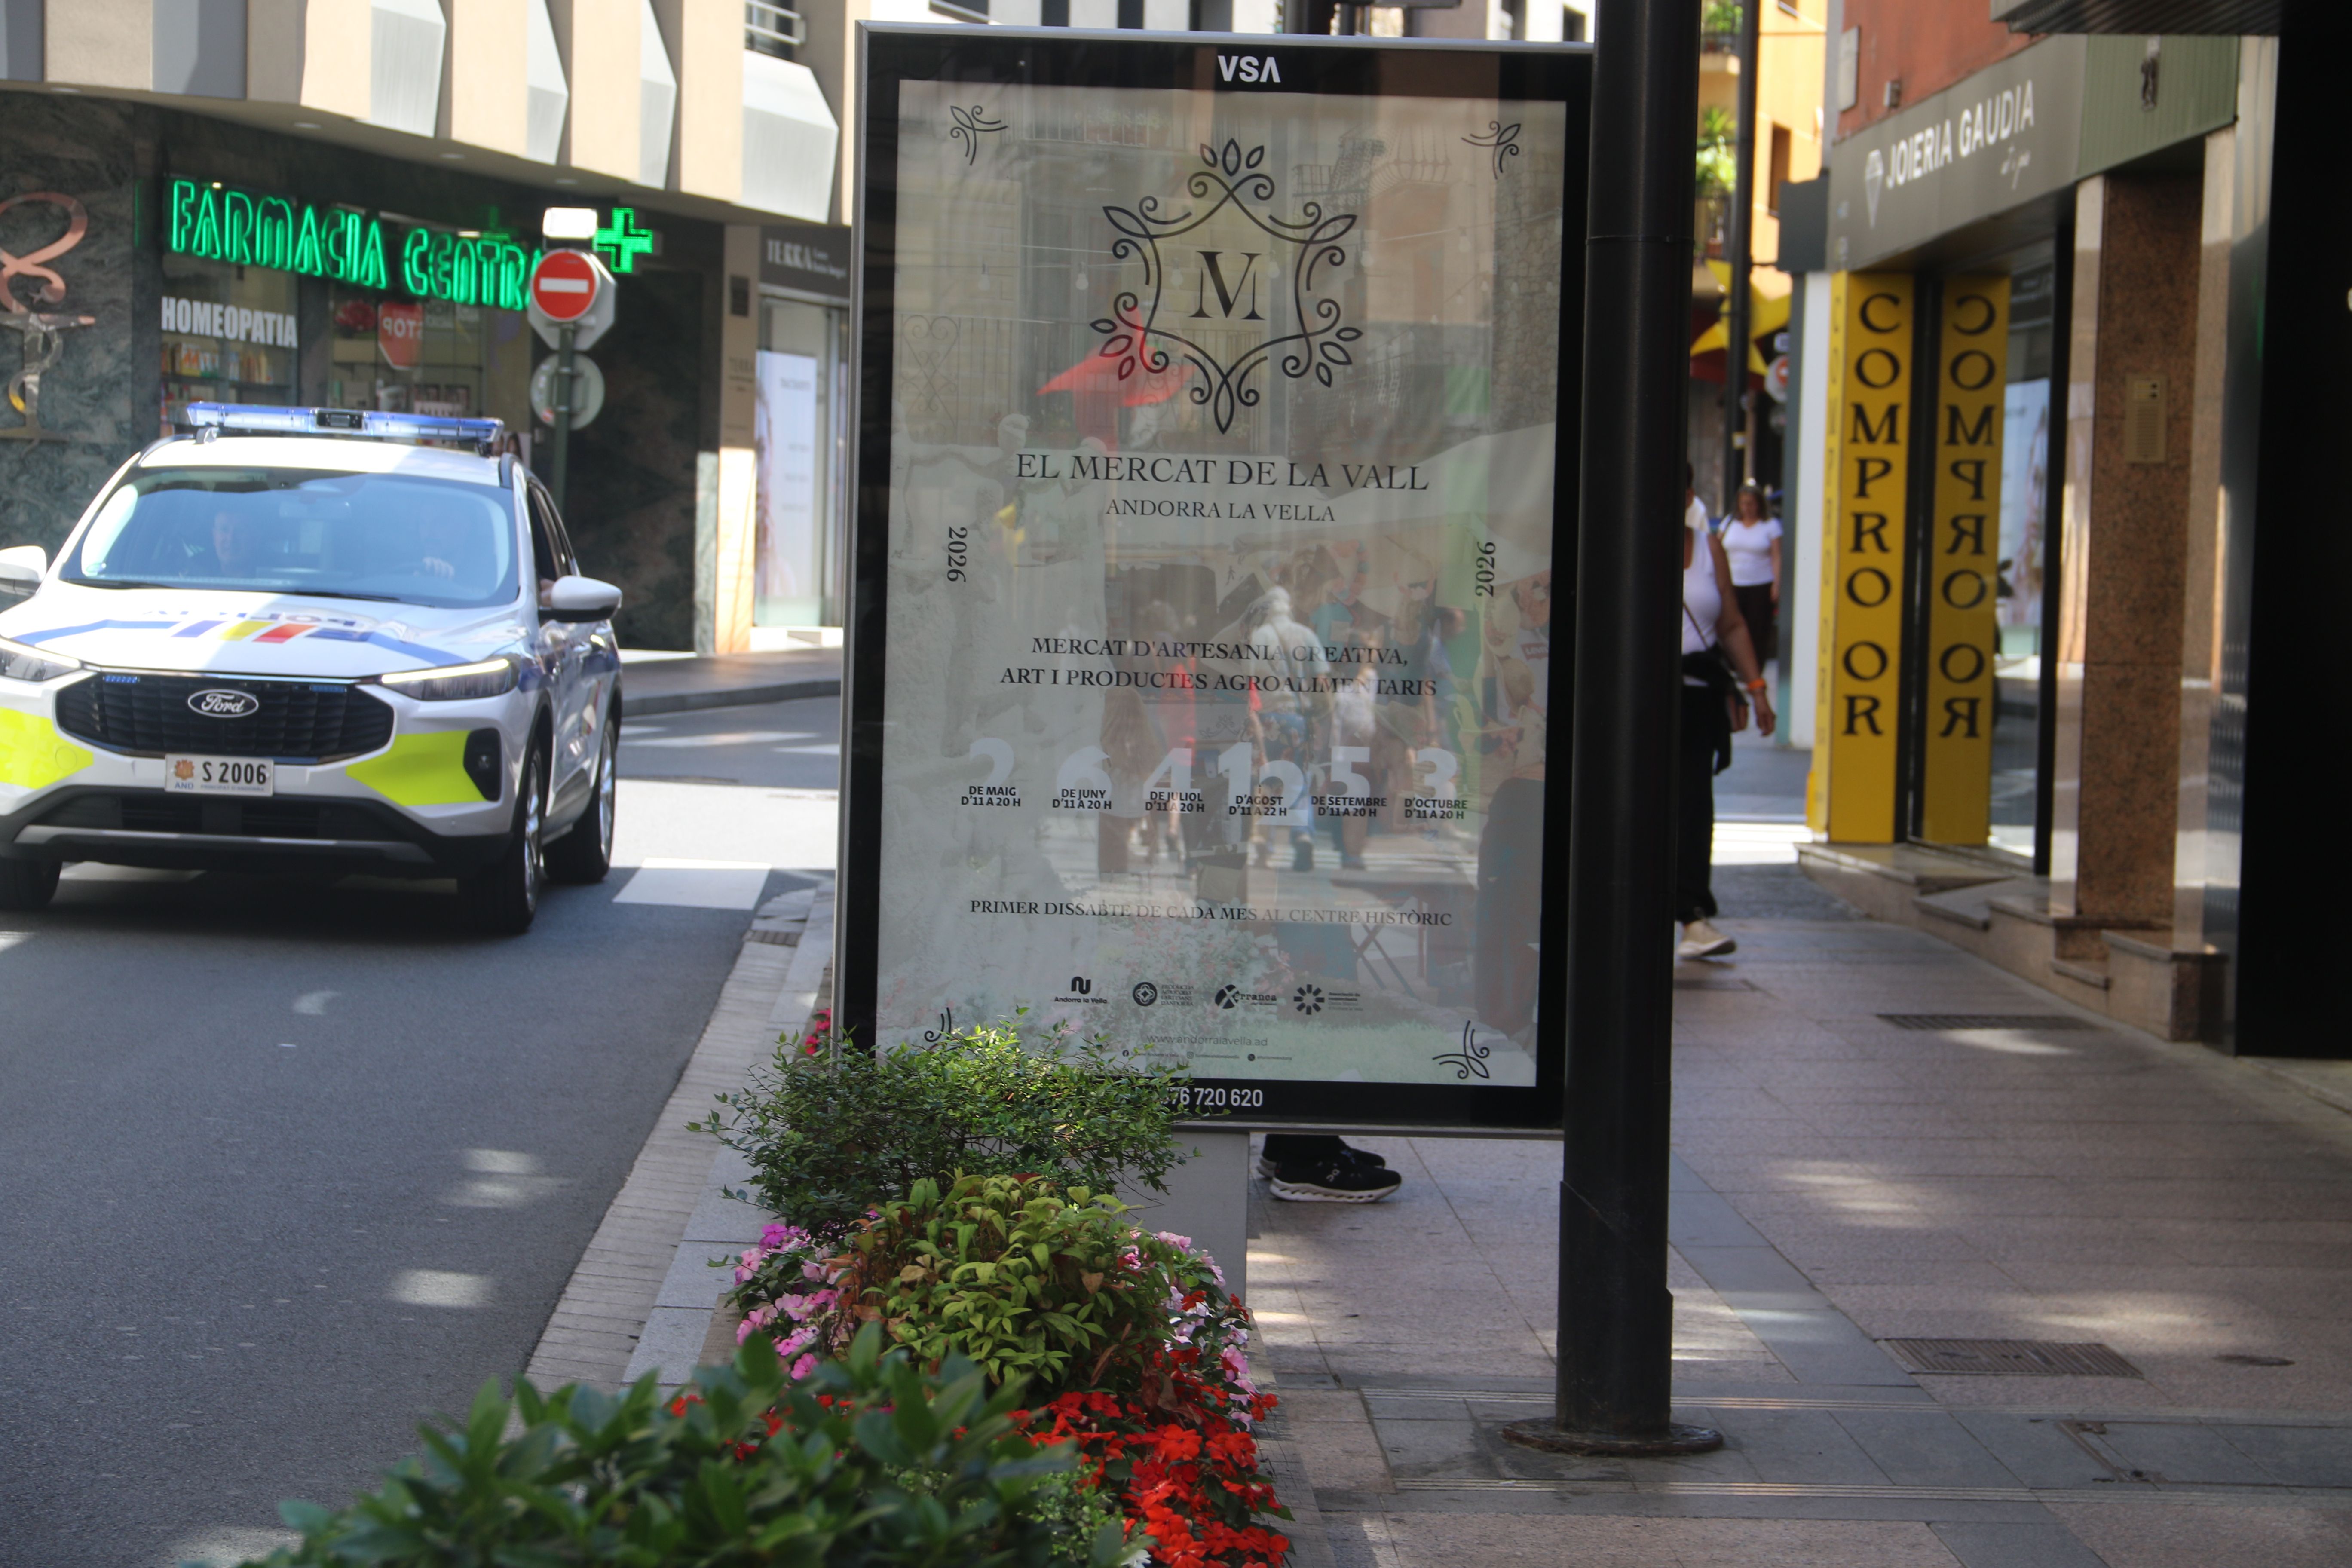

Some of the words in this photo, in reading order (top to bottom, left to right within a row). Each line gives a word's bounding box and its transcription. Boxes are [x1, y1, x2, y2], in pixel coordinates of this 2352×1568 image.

[1886, 119, 1953, 190] JOIERIA
[1958, 79, 2035, 158] GAUDIA
[172, 180, 388, 290] FARMACIA
[1188, 250, 1267, 321] M
[161, 296, 298, 349] HOMEOPATIA
[1846, 293, 1902, 608] COMPRO
[1015, 453, 1060, 479] EL
[1069, 455, 1217, 484] MERCAT
[1227, 460, 1277, 486] DE
[1287, 462, 1331, 487] LA
[1340, 464, 1429, 490] VALL
[1106, 499, 1222, 518] ANDORRA
[1228, 502, 1256, 519] LA
[1262, 504, 1336, 522] VELLA
[946, 526, 968, 582] 2026
[1475, 541, 1496, 597] 2026
[1032, 637, 1128, 655] MERCAT
[1133, 640, 1286, 661] D'ARTESANIA
[1292, 645, 1409, 668] CREATIVA,
[1000, 668, 1045, 684] ART
[1050, 669, 1058, 685] I
[1066, 669, 1208, 689] PRODUCTES
[1214, 675, 1437, 696] AGROALIMENTARIS
[1843, 640, 1889, 736] OR
[201, 693, 245, 713] Ford
[202, 761, 213, 782] S
[218, 762, 266, 785] 2006
[1143, 747, 1201, 814] 4
[1326, 746, 1371, 812] 5
[1414, 747, 1457, 814] 3
[175, 781, 194, 790] AND
[968, 786, 983, 795] DE
[986, 786, 1016, 796] MAIG
[1061, 788, 1076, 798] DE
[1077, 789, 1106, 800] JUNY
[1150, 791, 1164, 801] DE
[1166, 791, 1203, 802] JULIOL
[961, 796, 983, 806] D'11
[986, 797, 994, 806] A
[996, 797, 1010, 807] 20
[1012, 798, 1021, 807] H
[1052, 798, 1075, 809] D'11
[1078, 799, 1085, 809] A
[1087, 800, 1101, 809] 20
[1103, 800, 1112, 810] H
[1145, 801, 1168, 811] D'11
[1170, 802, 1178, 812] A
[1180, 802, 1194, 812] 20
[1196, 803, 1205, 812] H
[1229, 805, 1252, 815] D'11
[1254, 807, 1262, 815] A
[1264, 807, 1276, 816] 22
[1279, 807, 1287, 816] H
[1235, 794, 1283, 805] D'AGOST
[1311, 796, 1325, 805] DE
[1327, 796, 1387, 807] SETEMBRE
[1404, 797, 1468, 809] D'OCTUBRE
[1318, 806, 1341, 817] D'11
[1343, 808, 1351, 817] A
[1353, 808, 1366, 817] 20
[1369, 808, 1377, 818] H
[1404, 808, 1427, 819] D'11
[1429, 809, 1438, 819] A
[1439, 810, 1454, 820] 20
[1456, 810, 1464, 820] H
[970, 900, 1040, 915] PRIMER
[1044, 902, 1130, 917] DISSABTE
[1136, 905, 1161, 918] DE
[1166, 905, 1216, 919] CADA
[1220, 906, 1257, 921] MES
[1262, 908, 1285, 922] AL
[1289, 908, 1360, 923] CENTRE
[1365, 909, 1452, 925] HISTÒRIC
[1146, 1034, 1268, 1047] www.andorralavella.ad
[1194, 1087, 1226, 1106] 720
[1230, 1088, 1263, 1107] 620
